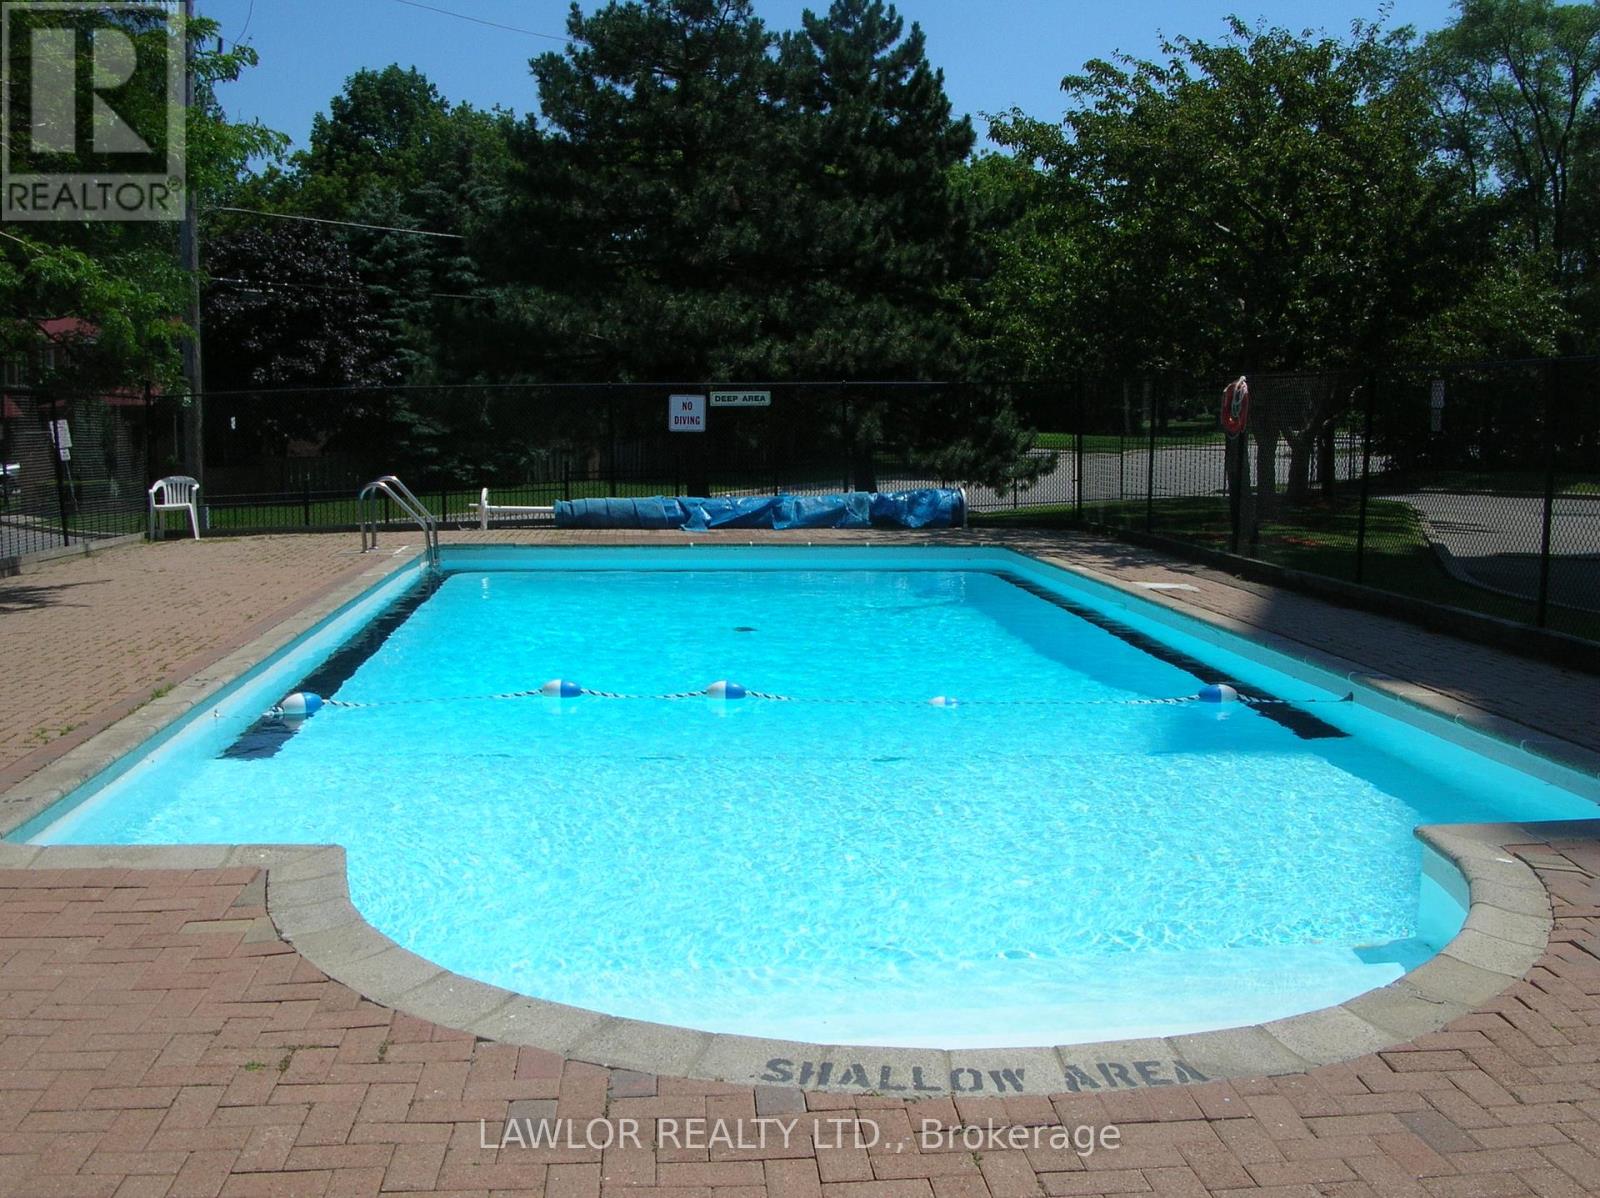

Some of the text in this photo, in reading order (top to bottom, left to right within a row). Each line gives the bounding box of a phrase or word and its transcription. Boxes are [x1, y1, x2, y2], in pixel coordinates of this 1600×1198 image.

[682, 401, 693, 411] NO
[674, 415, 701, 425] DIVING
[759, 1058, 1210, 1093] SHALLOW AREA
